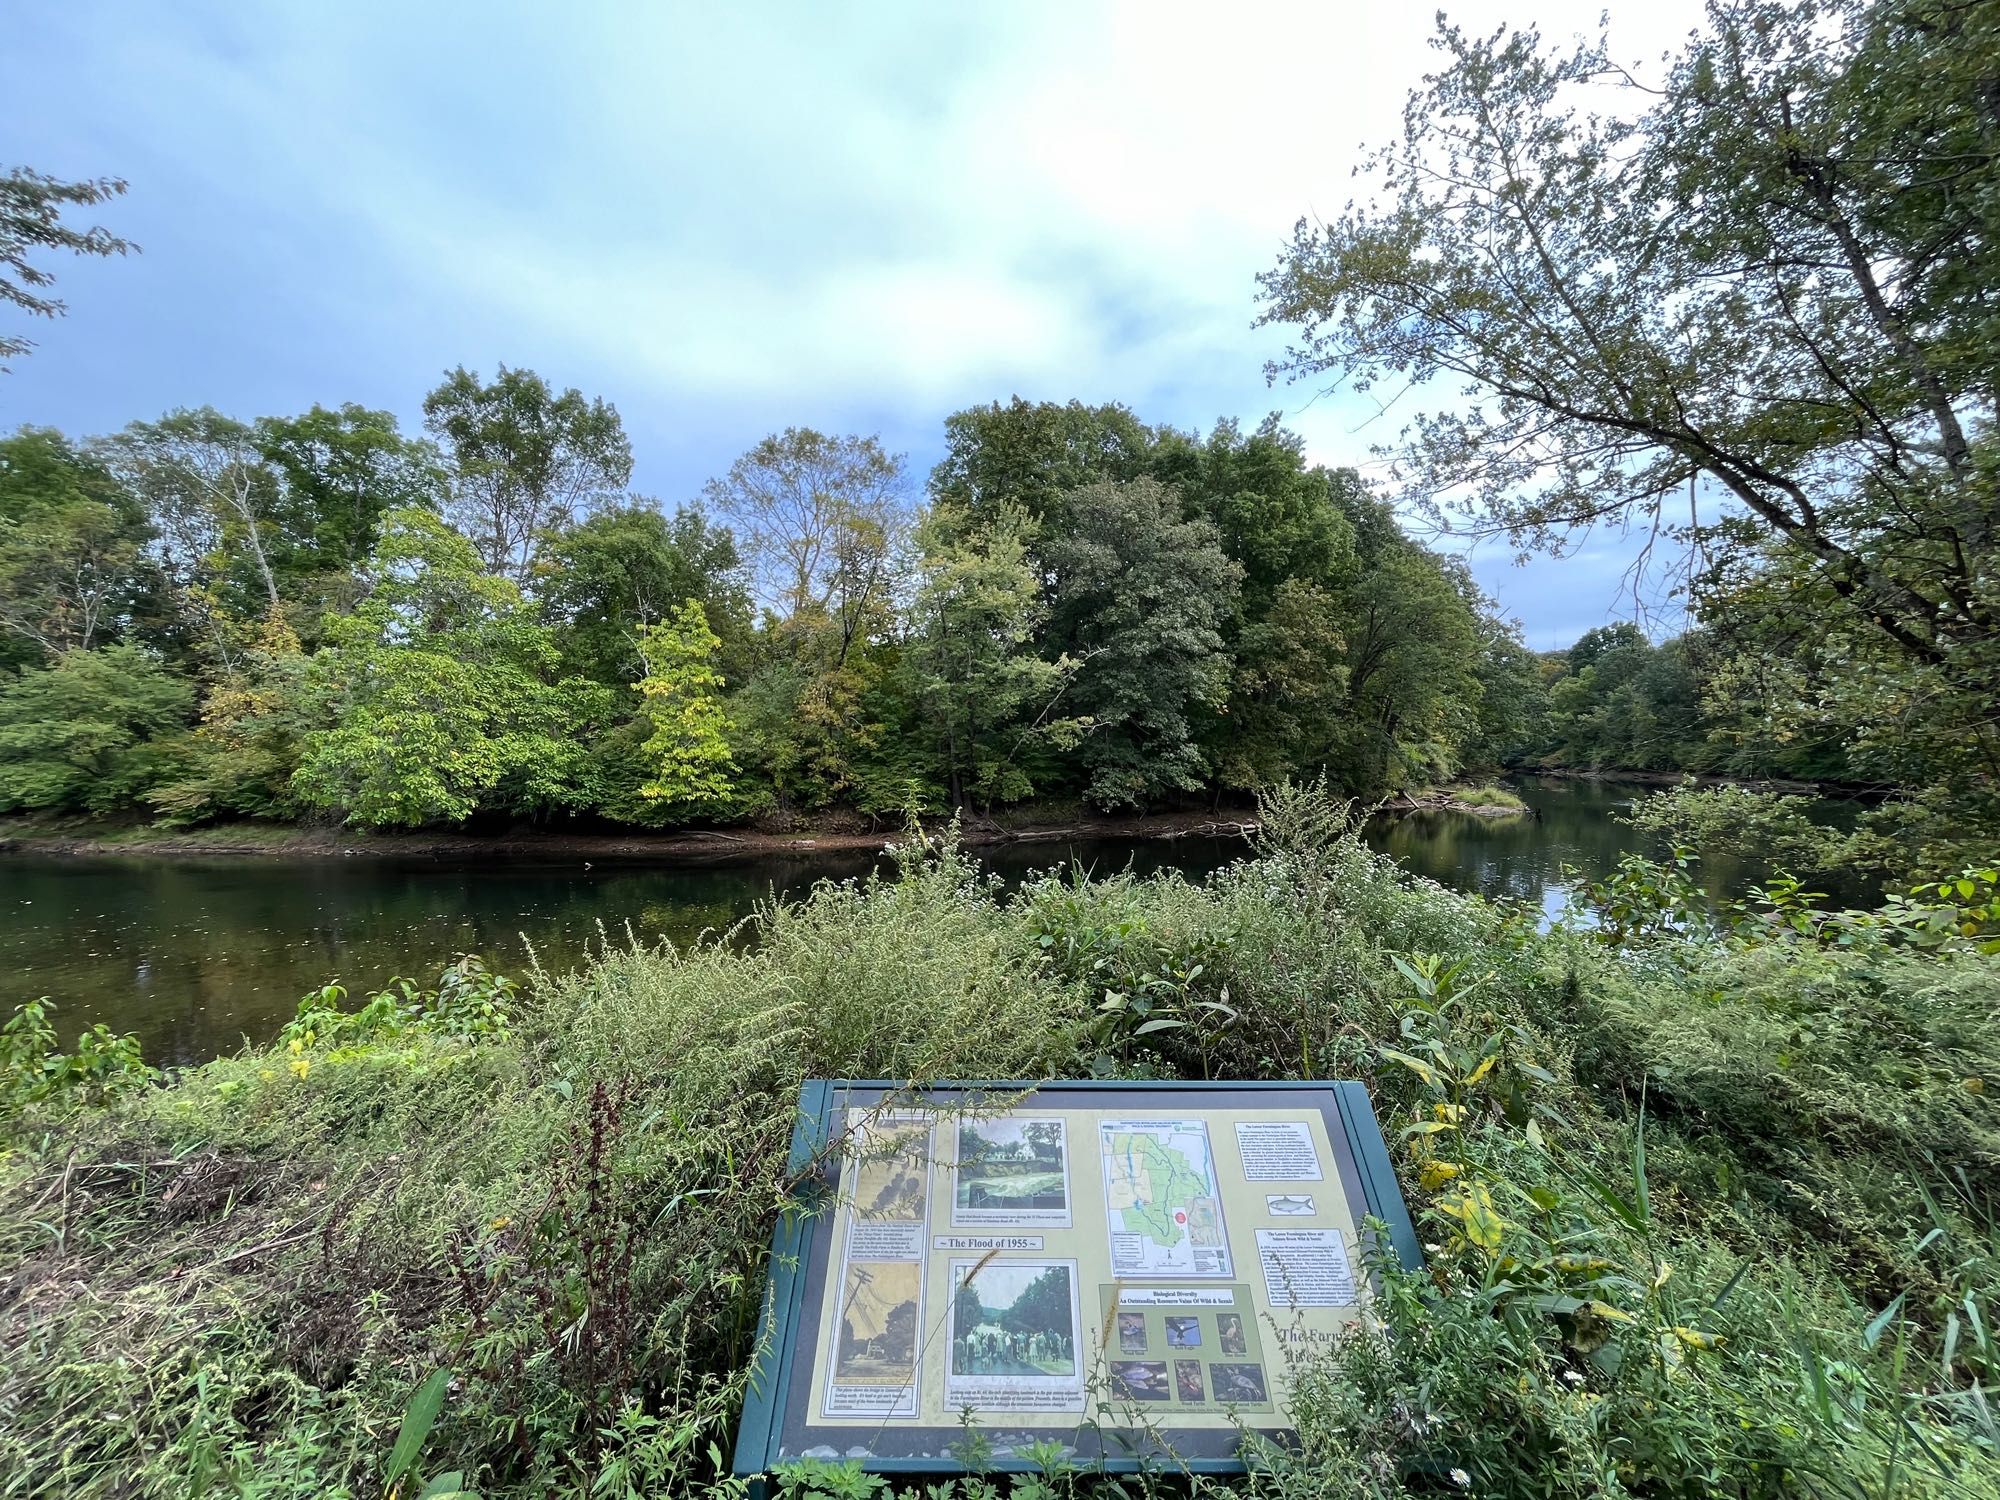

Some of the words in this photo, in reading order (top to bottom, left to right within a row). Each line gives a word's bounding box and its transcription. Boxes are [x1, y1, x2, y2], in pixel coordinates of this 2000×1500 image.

[948, 1238, 966, 1248] The
[968, 1238, 993, 1248] Flood
[995, 1238, 1005, 1248] of
[1007, 1238, 1028, 1248] 1955
[1279, 1328, 1305, 1342] The
